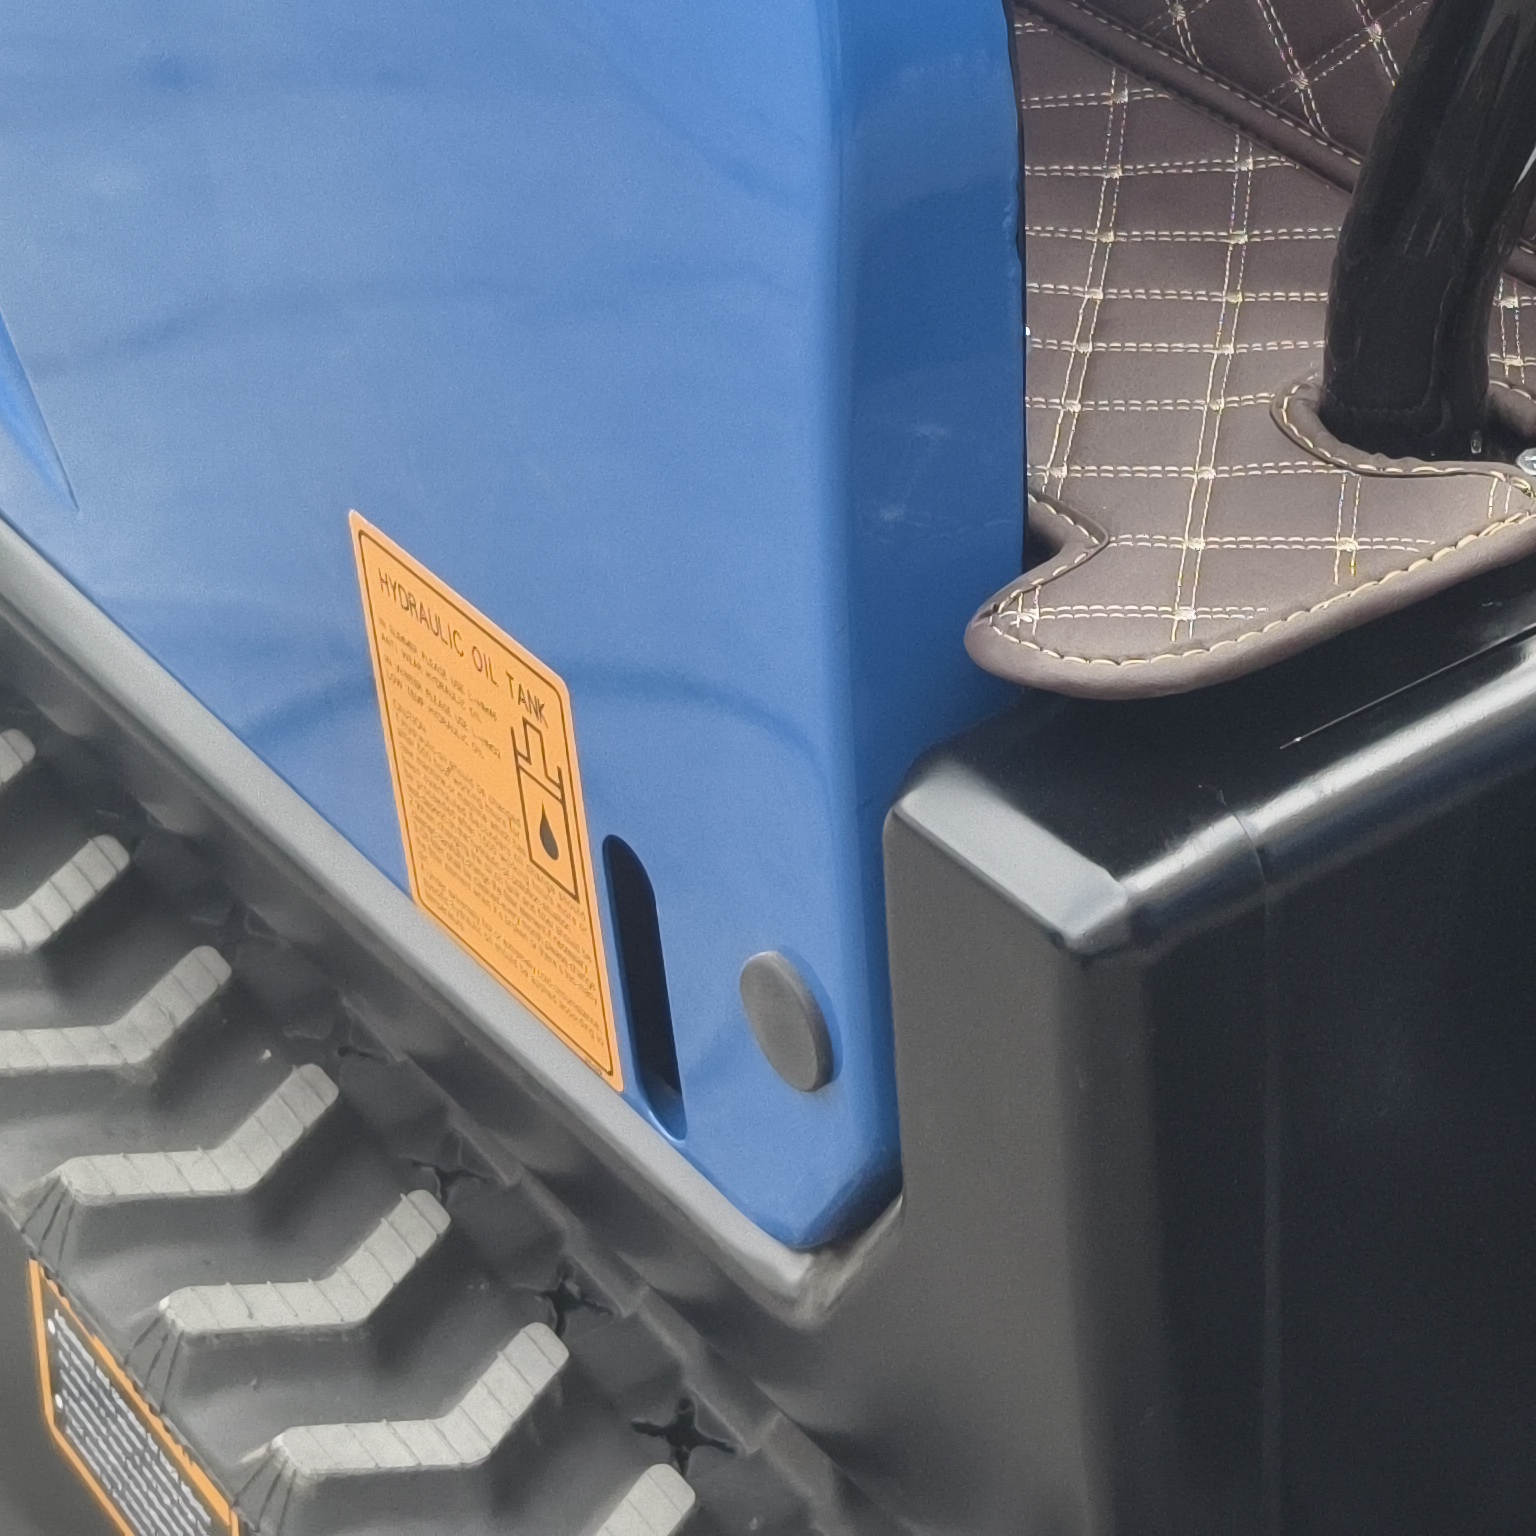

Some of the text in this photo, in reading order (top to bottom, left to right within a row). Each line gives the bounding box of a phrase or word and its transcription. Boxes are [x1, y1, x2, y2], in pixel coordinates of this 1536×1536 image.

[377, 567, 465, 660] HYDRAULIC
[470, 642, 499, 688] OIL
[505, 669, 549, 730] TANK
